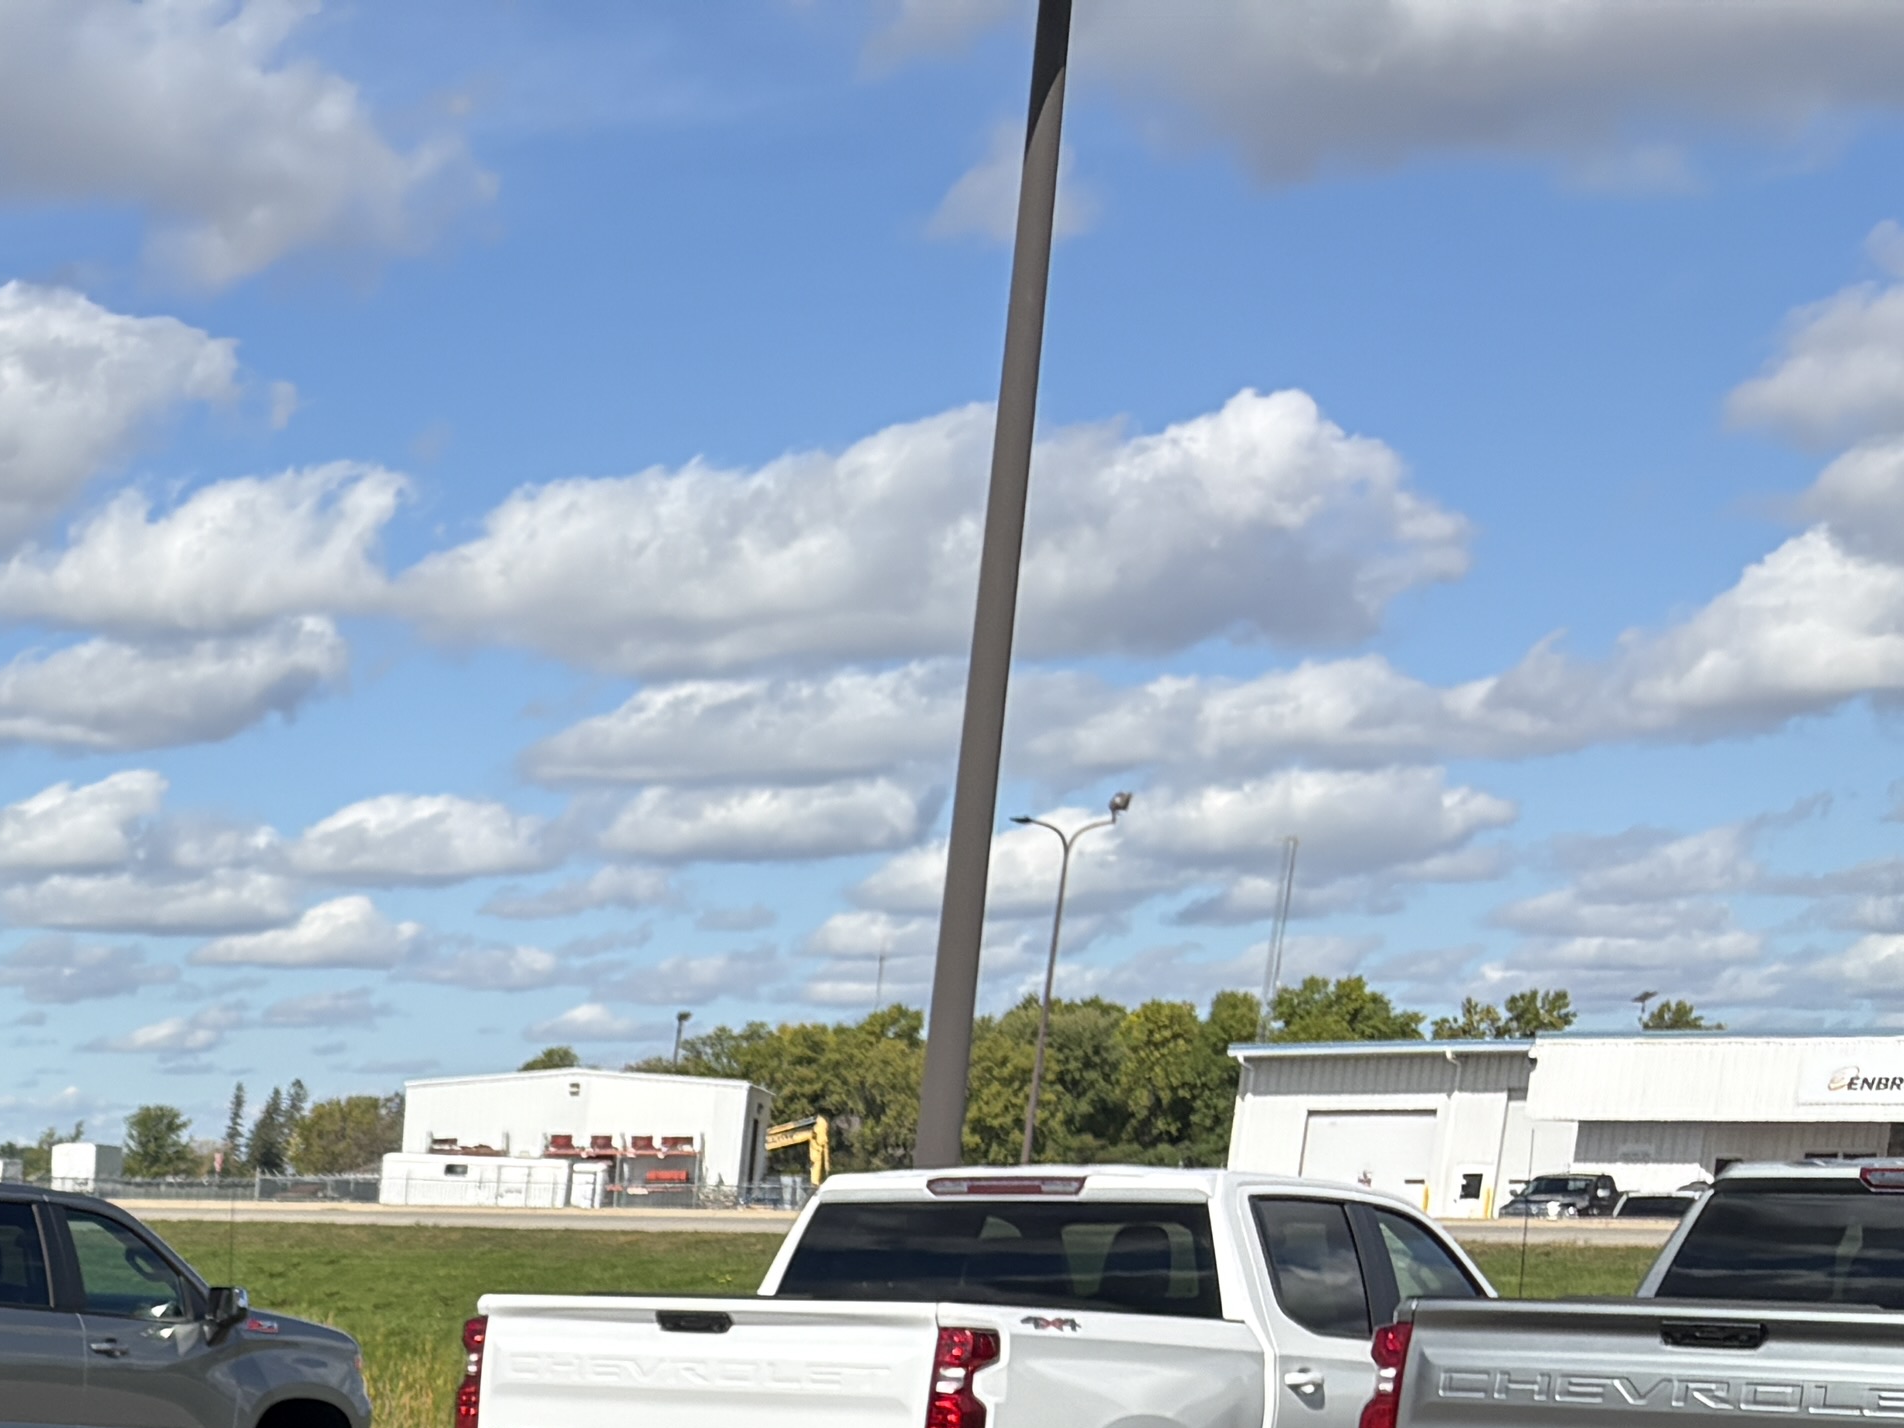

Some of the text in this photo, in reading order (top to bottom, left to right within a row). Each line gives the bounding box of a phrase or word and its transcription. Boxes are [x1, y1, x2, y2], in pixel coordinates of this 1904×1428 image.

[1847, 1076, 1904, 1091] ENBR
[505, 1351, 891, 1391] CHEVROLET
[1437, 1369, 1904, 1418] CHEVROLE
